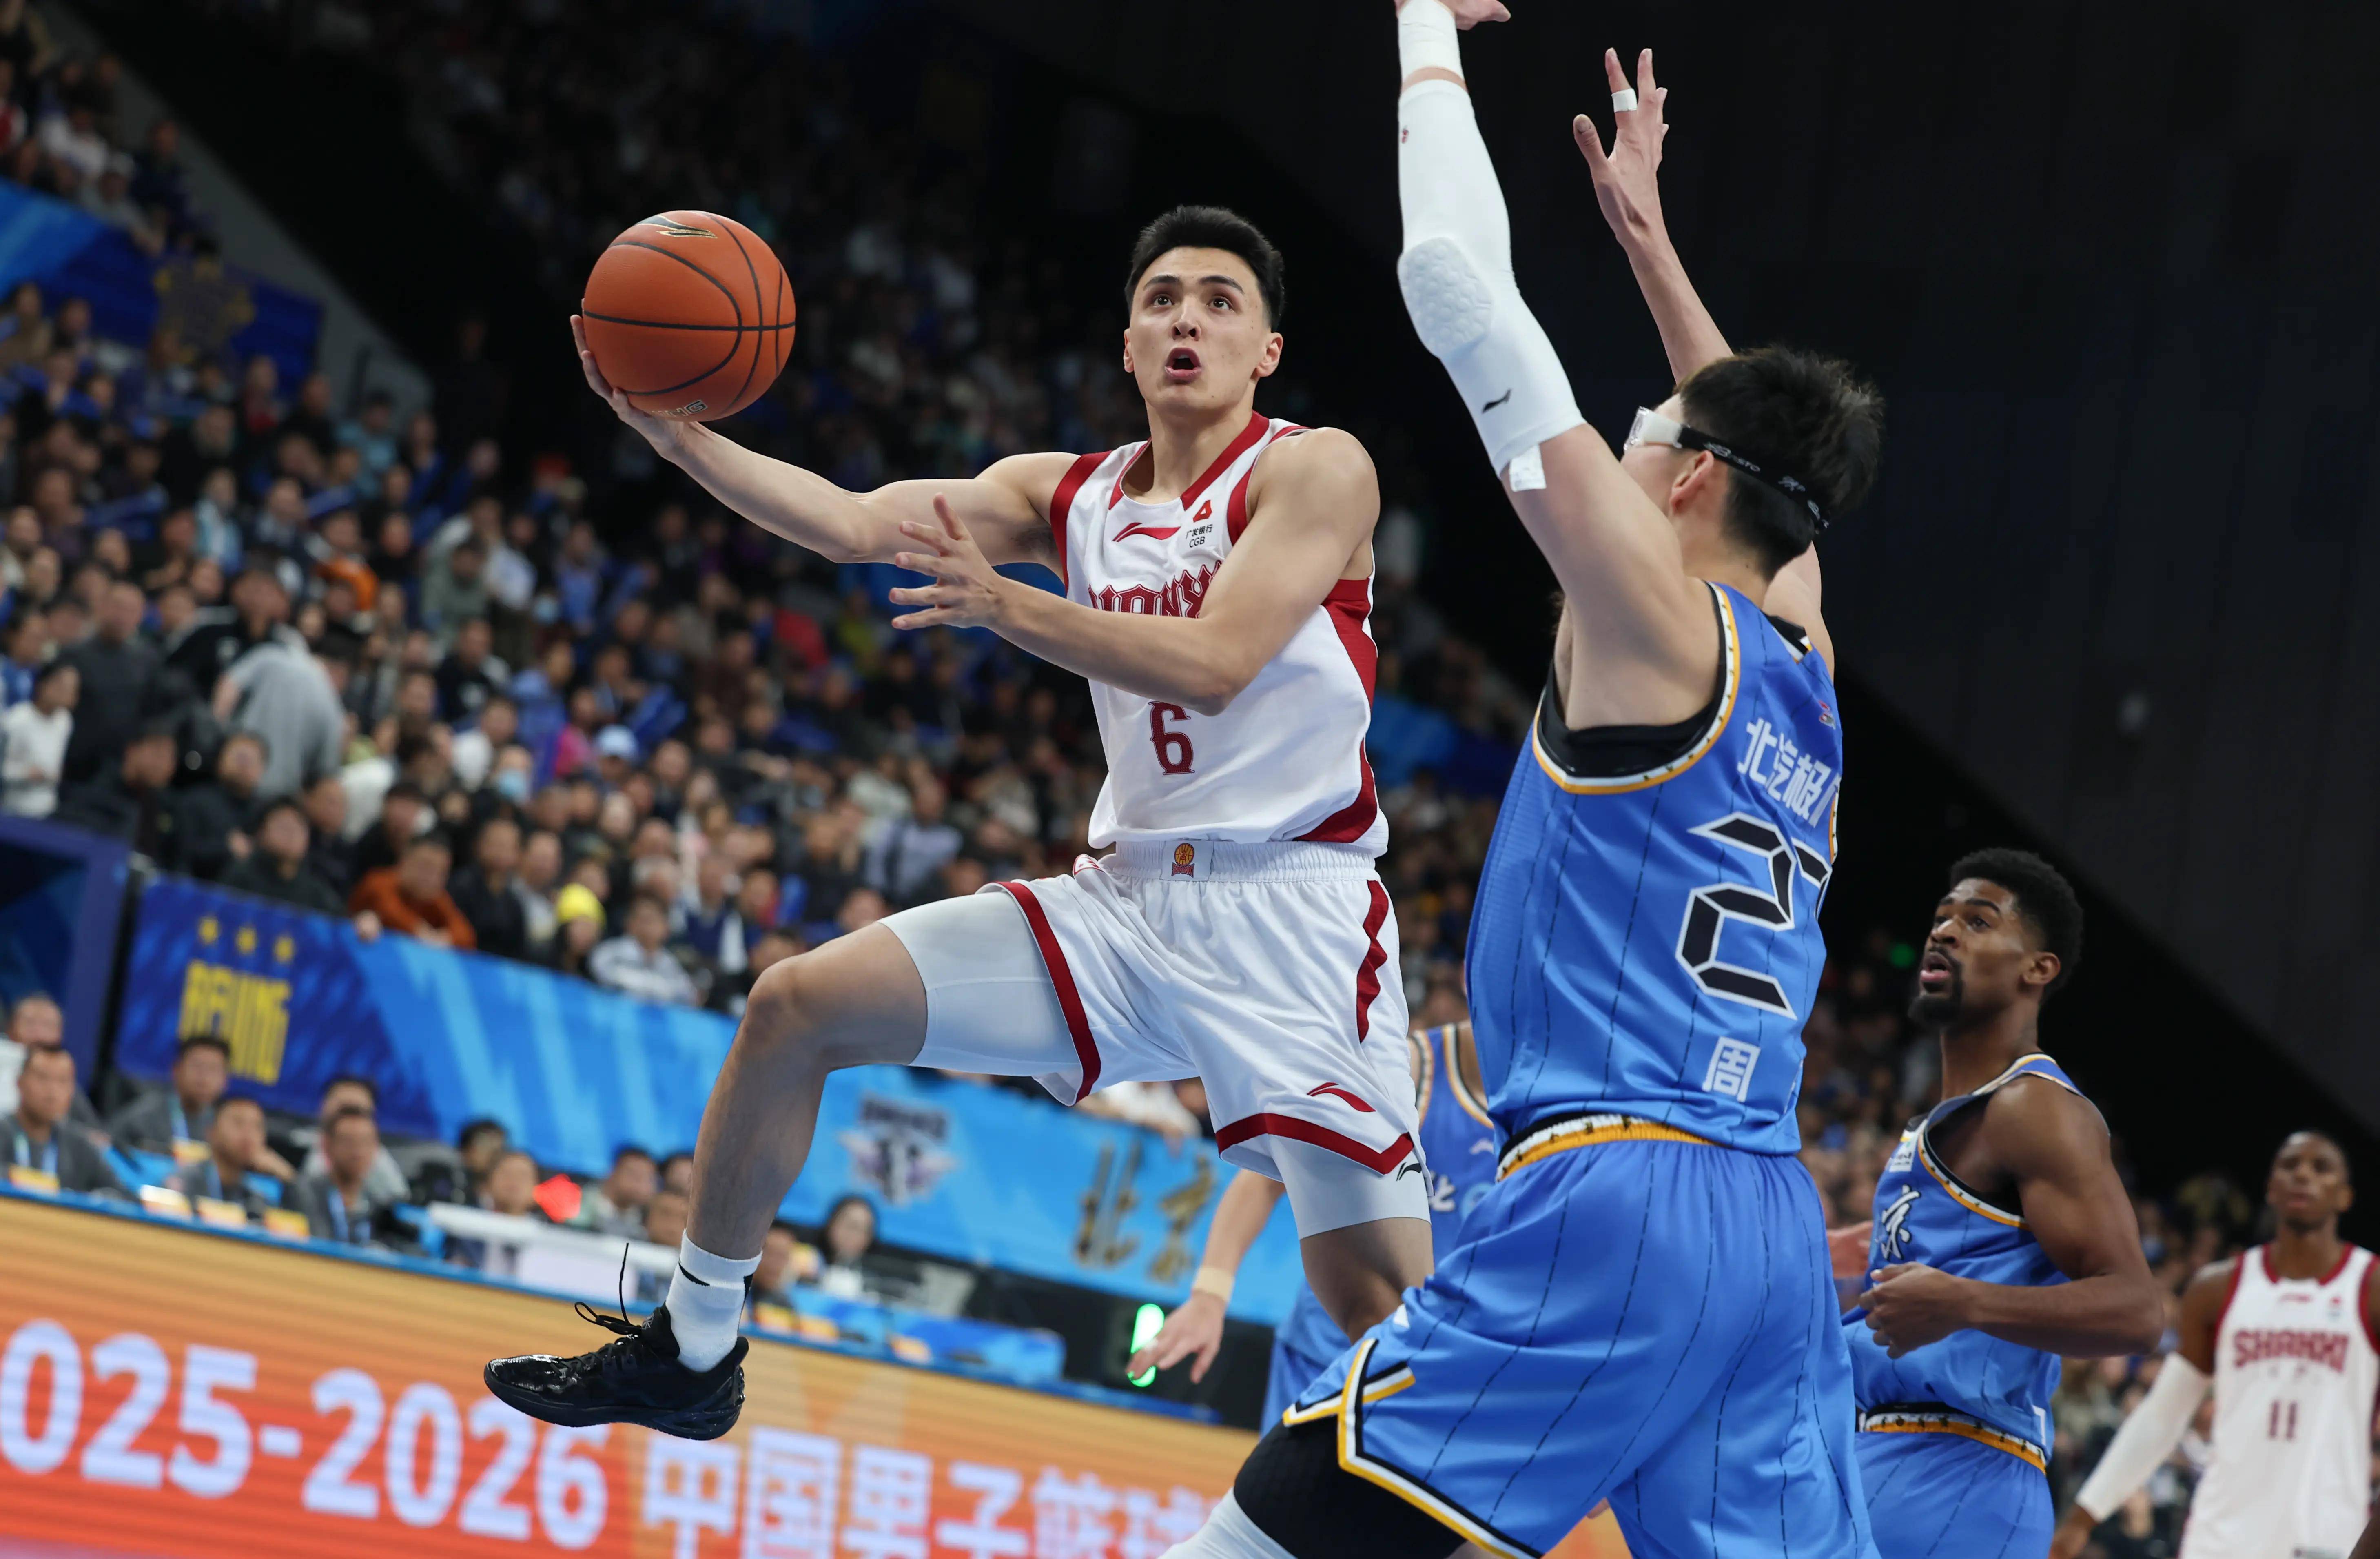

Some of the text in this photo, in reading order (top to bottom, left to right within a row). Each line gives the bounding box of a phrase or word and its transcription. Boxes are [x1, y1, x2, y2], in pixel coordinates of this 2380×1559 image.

[1186, 524, 1213, 539] 广发银行
[1189, 536, 1205, 548] CGB
[1148, 701, 1195, 775] 6
[1702, 1036, 1761, 1103] 周
[0, 1317, 610, 1550] 025-2026
[2268, 1399, 2298, 1442] 11
